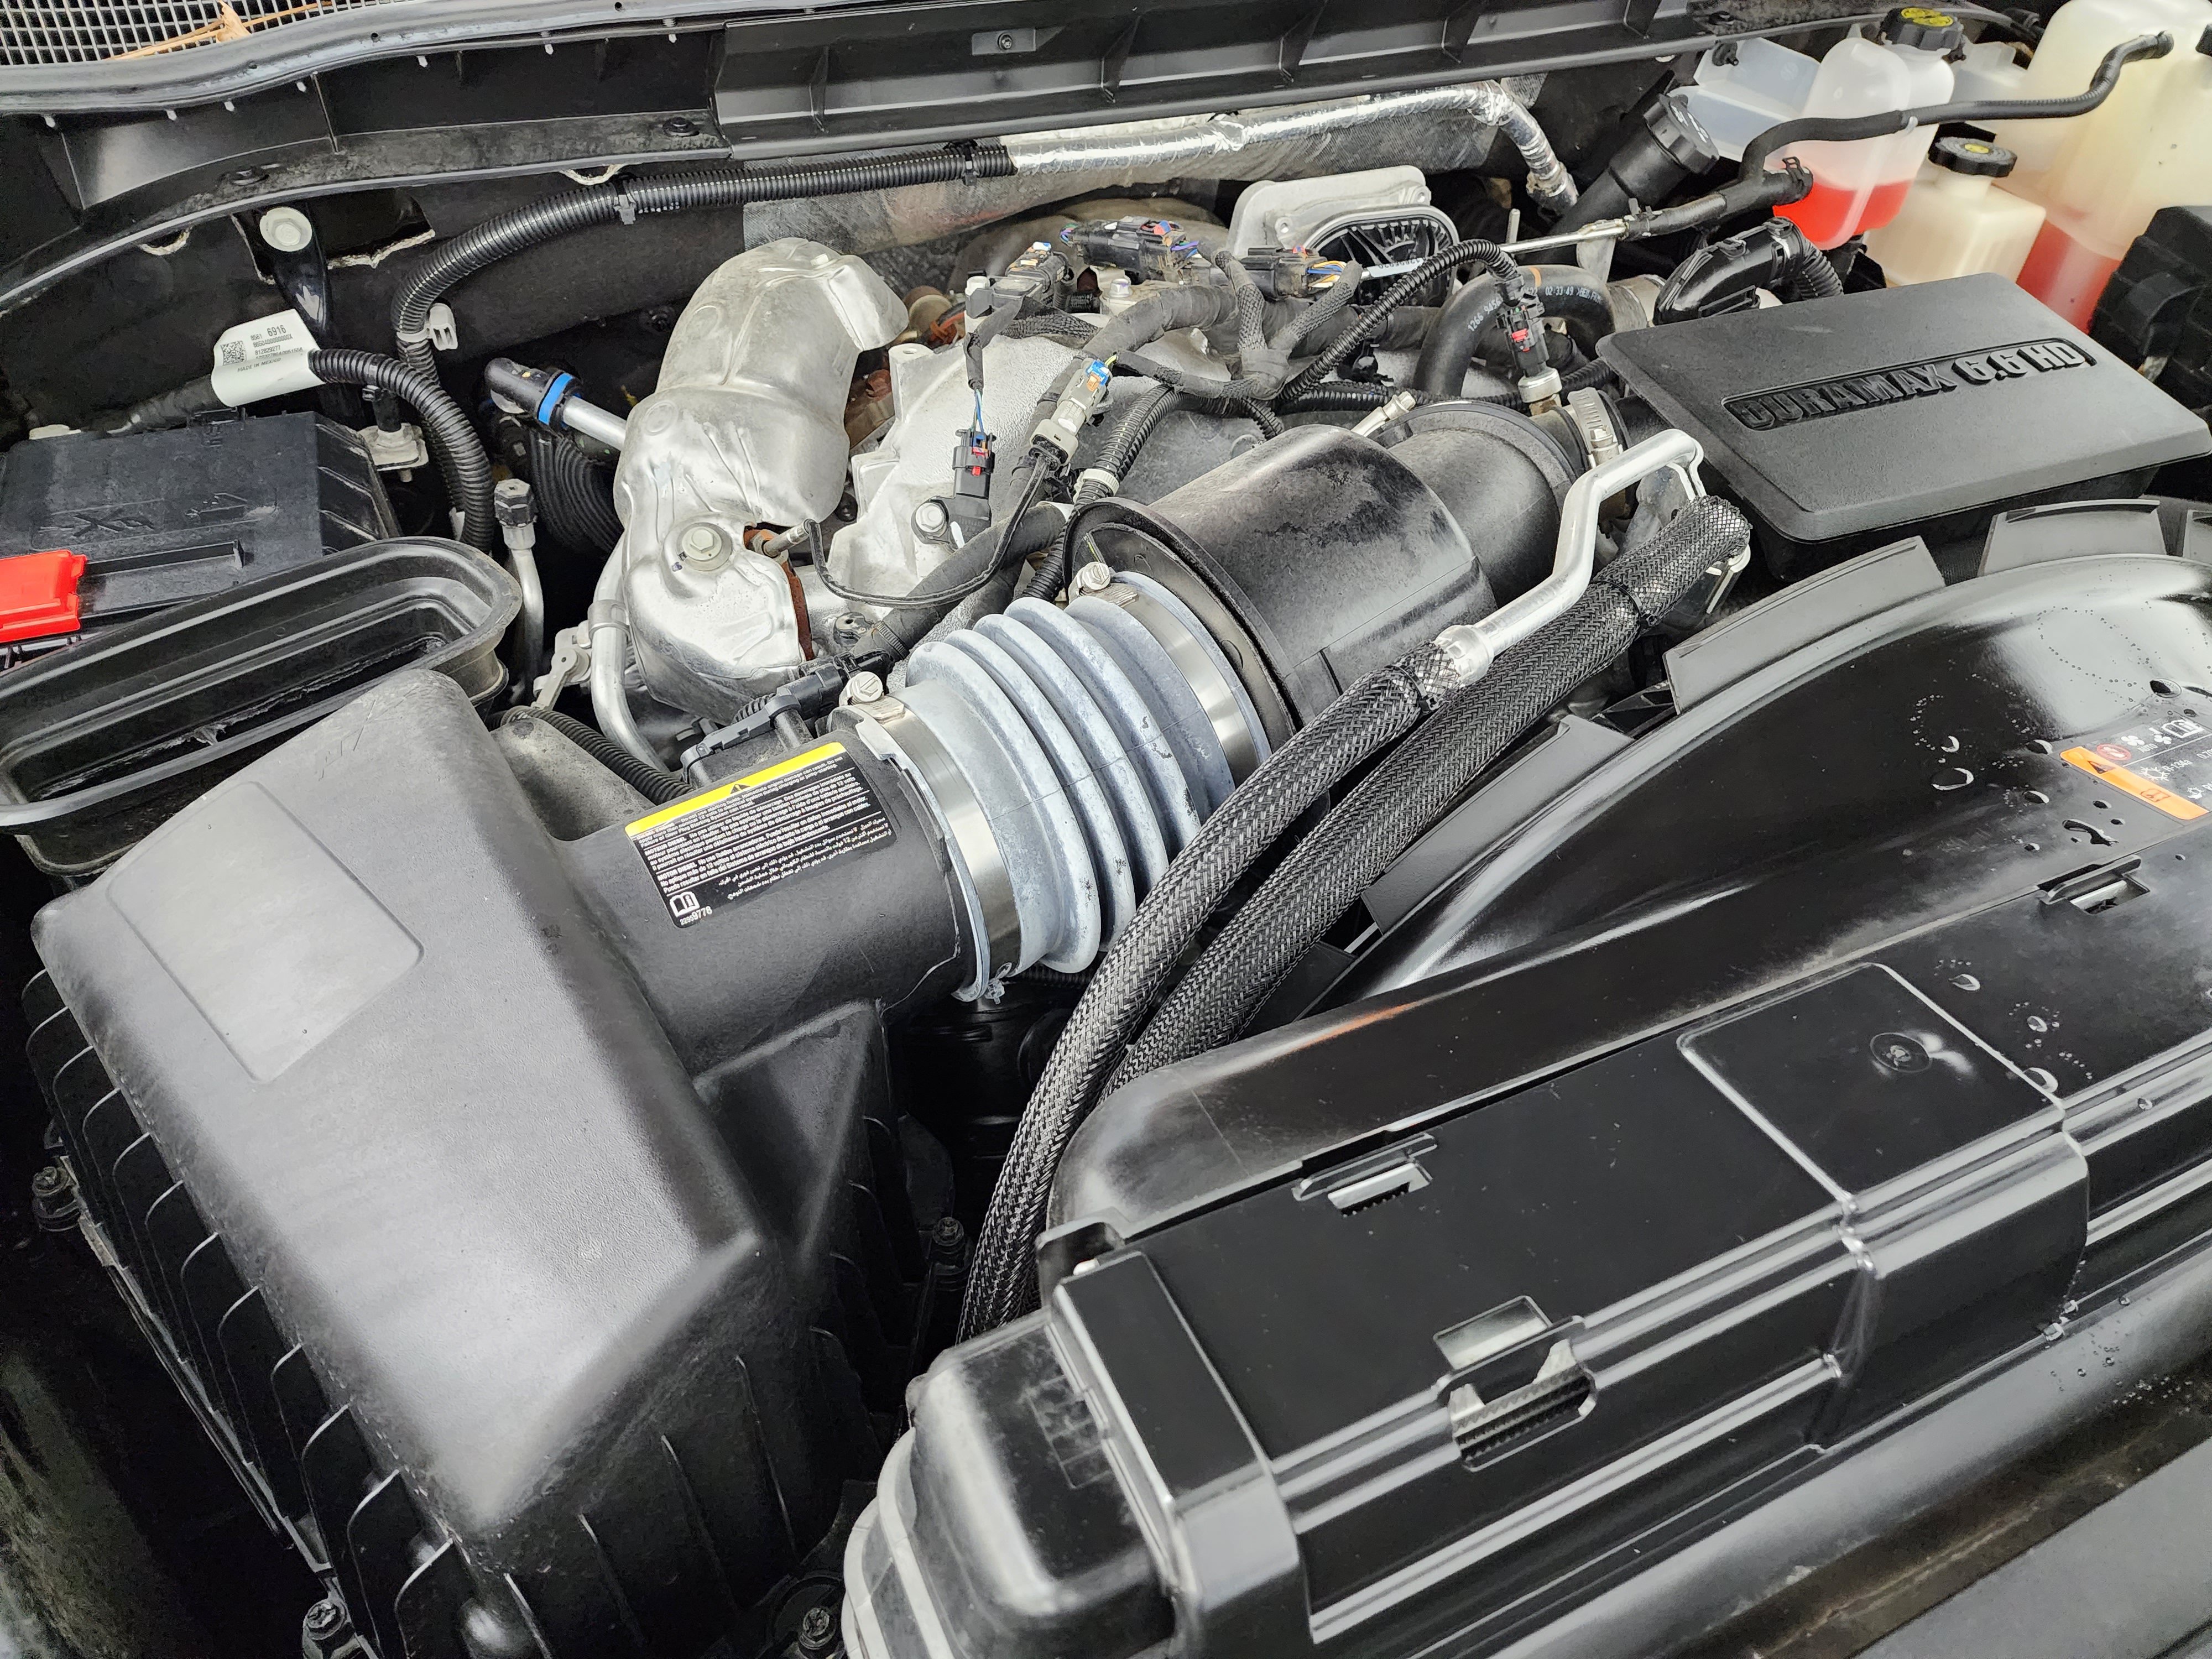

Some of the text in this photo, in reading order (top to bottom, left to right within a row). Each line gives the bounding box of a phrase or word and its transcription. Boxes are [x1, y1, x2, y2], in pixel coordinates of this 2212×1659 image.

[237, 364, 252, 372] MADE
[261, 357, 281, 366] MEXICO
[267, 325, 286, 337] 6916
[1740, 342, 2087, 428] DURAMAX 6.6 HD
[657, 869, 678, 881] MOTOR
[677, 862, 697, 873] DIESEL
[714, 848, 733, 858] fluidos
[732, 835, 766, 851] arrancadores.
[765, 829, 781, 838] Puede
[780, 822, 800, 832] resultar
[806, 813, 822, 822] daños
[821, 804, 847, 816] inmediatos
[851, 795, 868, 805] motor.
[663, 883, 680, 893] Puede
[679, 875, 700, 886] resultar
[706, 868, 719, 876] falla
[726, 856, 748, 868] Sistema
[754, 846, 777, 858] arranque
[782, 838, 795, 847] bujía
[794, 825, 830, 842] incandescente.
[667, 873, 688, 885] aplique
[686, 868, 699, 877] más
[712, 856, 729, 866] voltios
[734, 846, 755, 858] sistema
[754, 837, 777, 849] eléctrico
[776, 830, 795, 841] durante
[800, 824, 815, 833] carga
[823, 812, 845, 824] arranque
[852, 801, 870, 811] cables.
